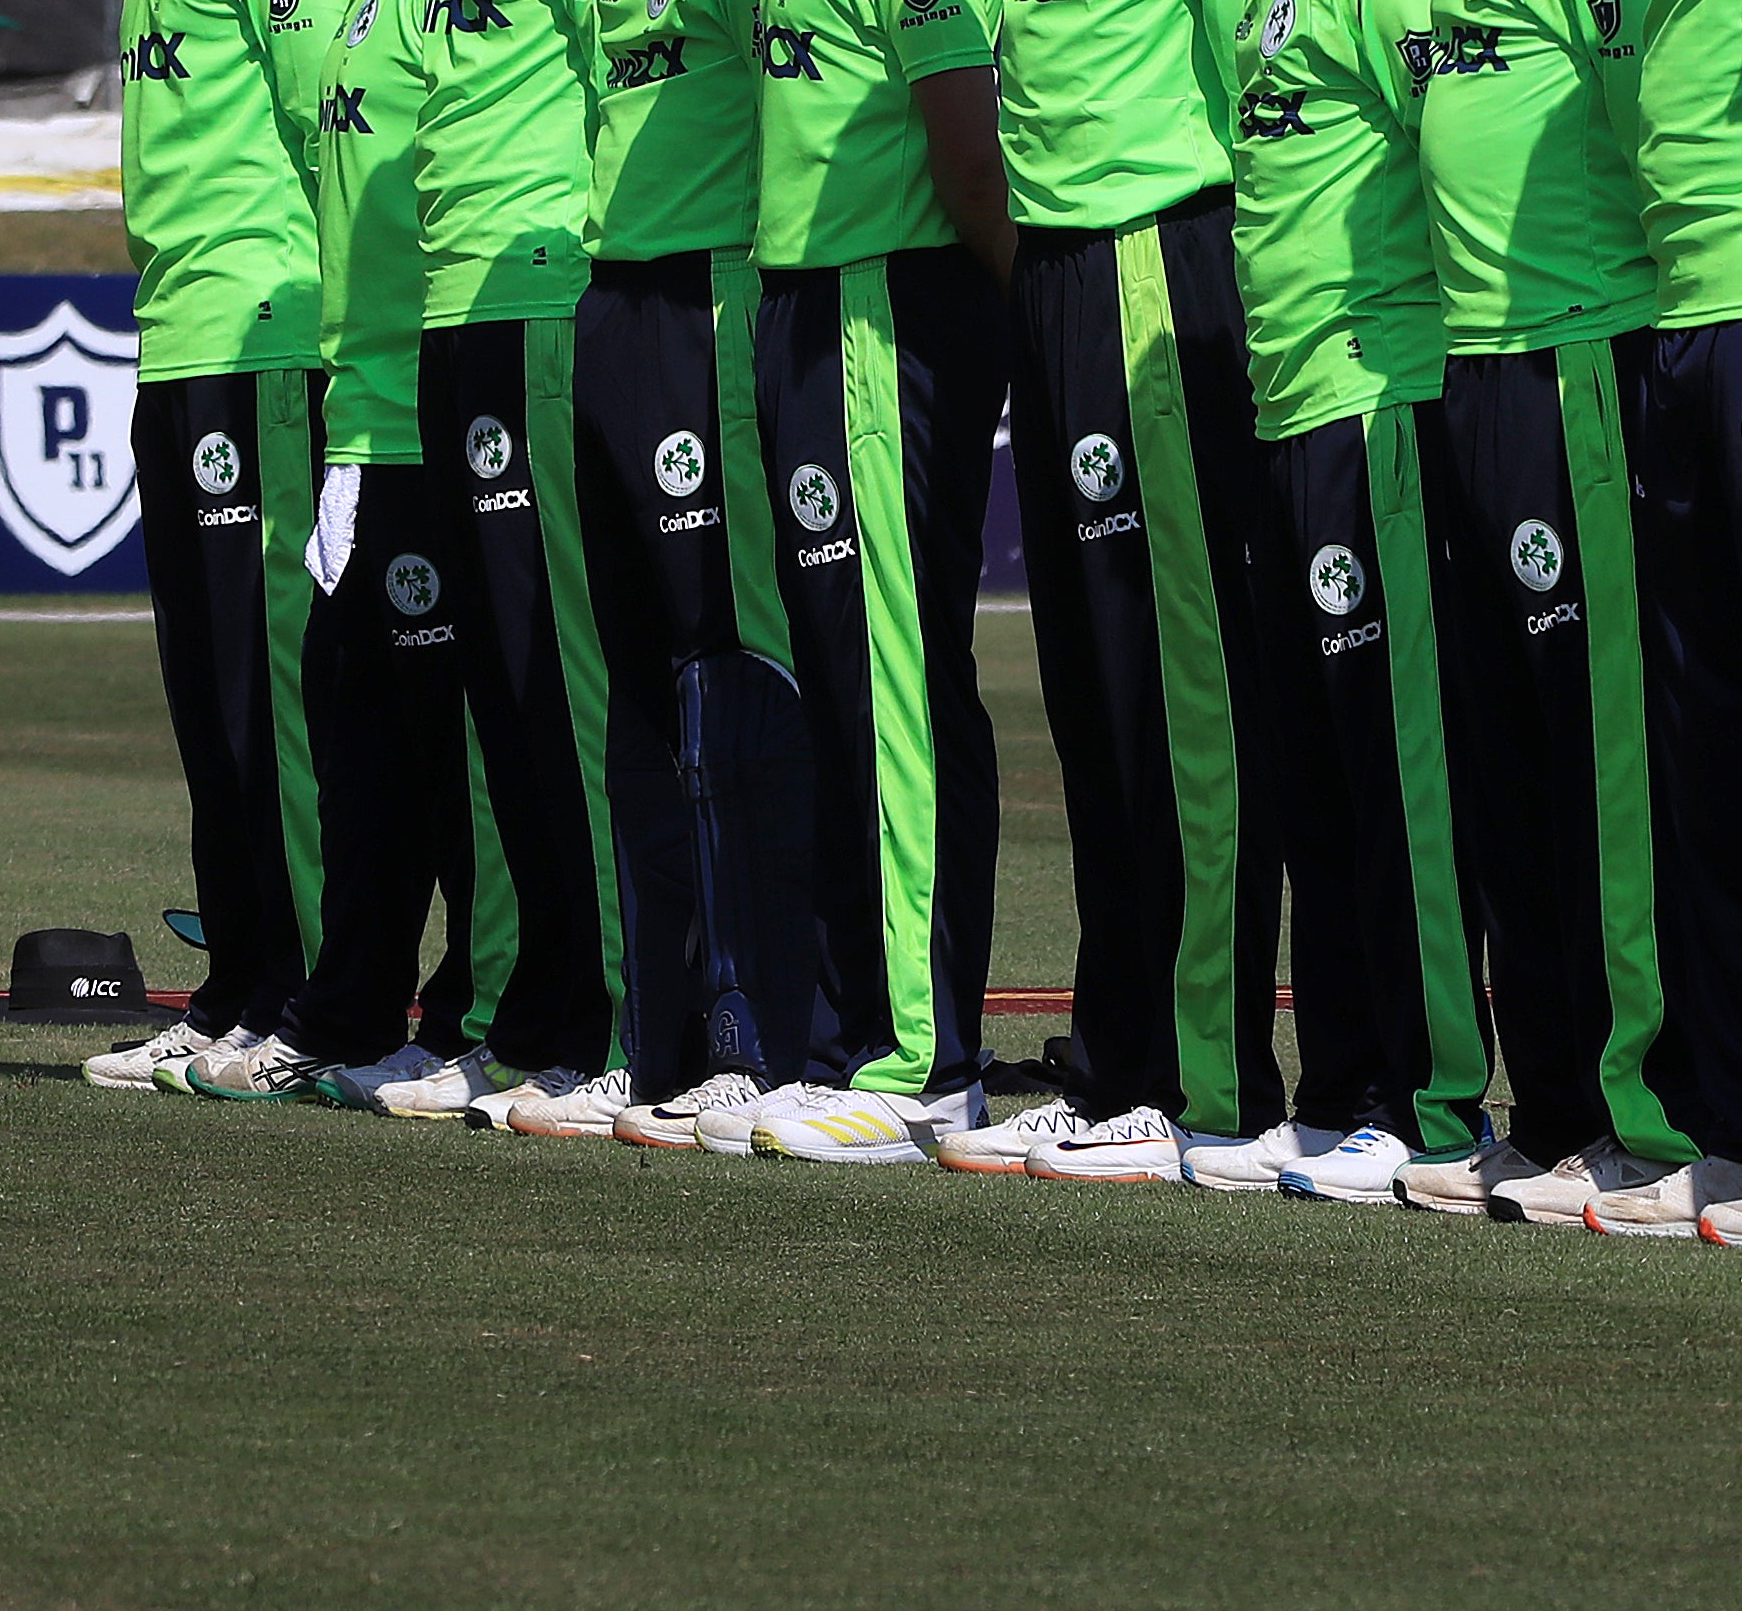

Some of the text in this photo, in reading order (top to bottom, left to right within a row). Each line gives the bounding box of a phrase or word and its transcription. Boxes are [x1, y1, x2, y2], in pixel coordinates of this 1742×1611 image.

[659, 506, 721, 535] CoinDCX
[1077, 510, 1143, 543] CoinDCX
[798, 537, 857, 568] CoinDCX
[90, 979, 122, 997] ICC
